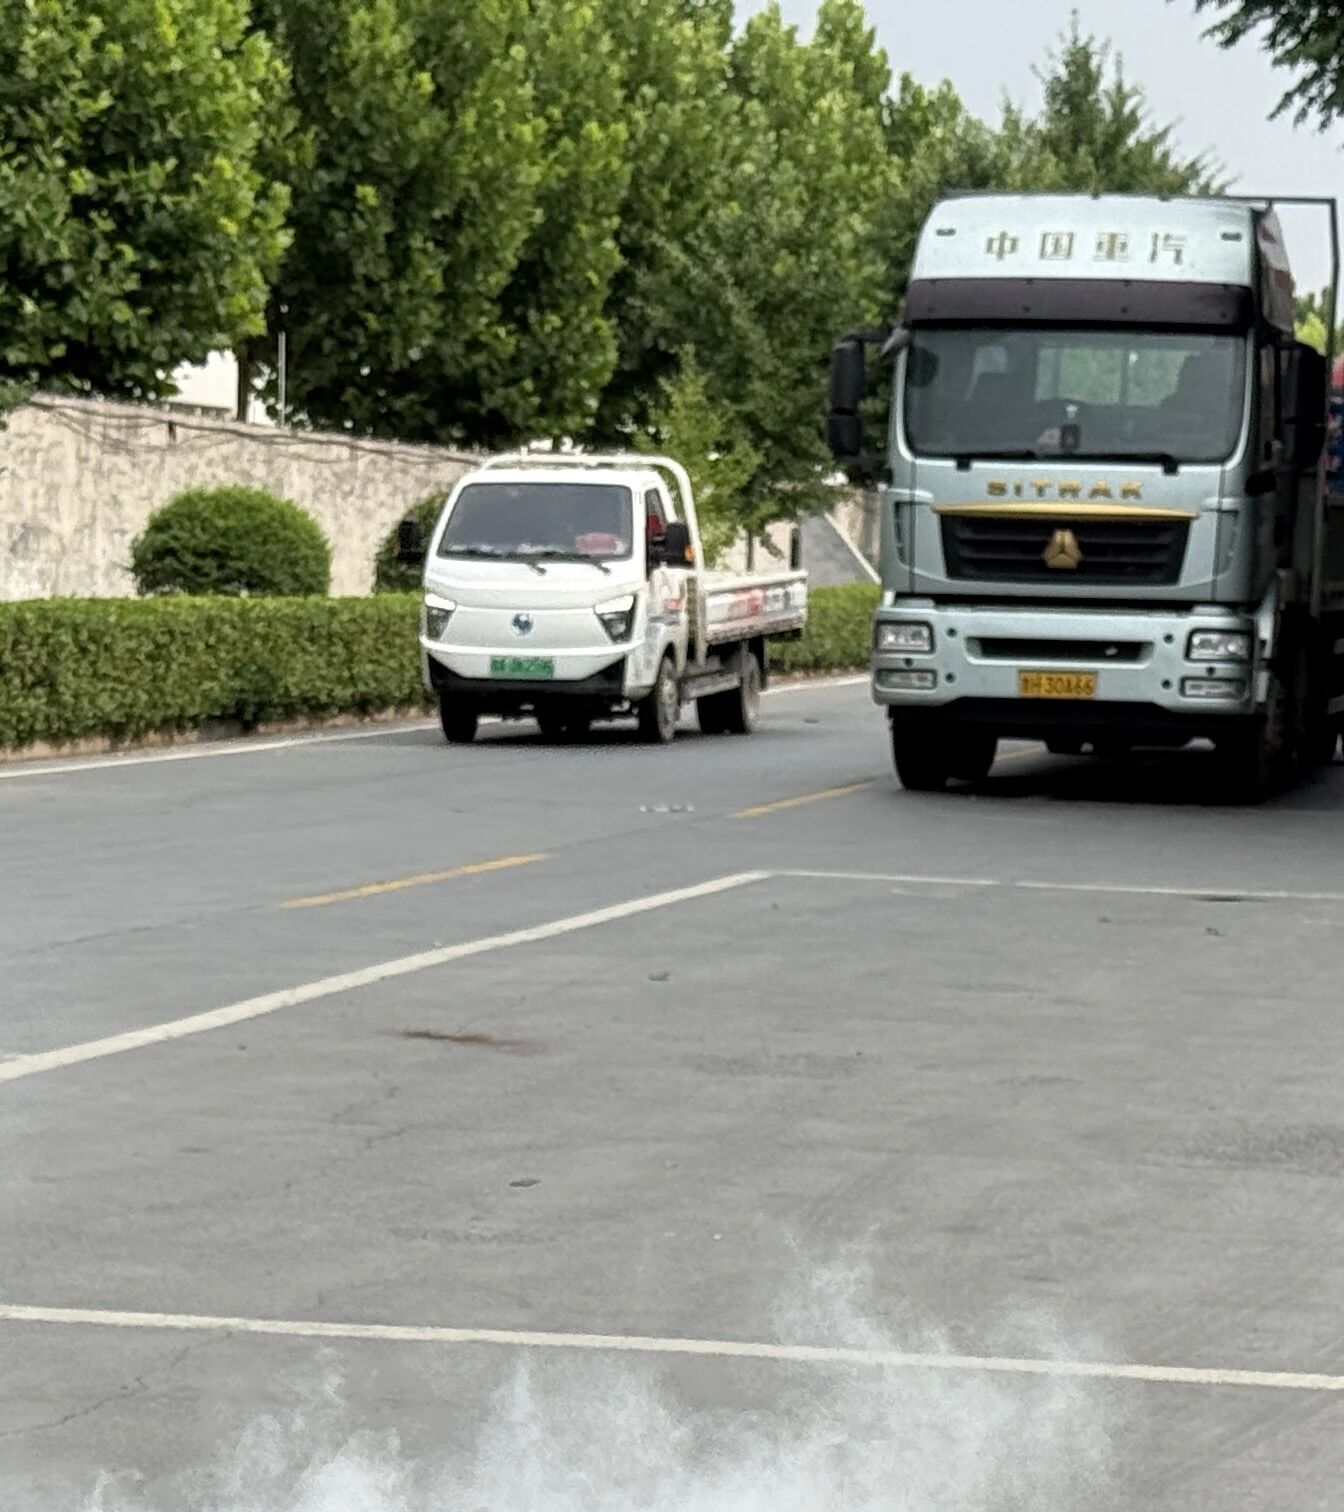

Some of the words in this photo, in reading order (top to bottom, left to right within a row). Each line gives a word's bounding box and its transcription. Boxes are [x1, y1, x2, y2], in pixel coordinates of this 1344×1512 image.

[985, 230, 1188, 265] 中国重汽
[986, 479, 1144, 500] SITRAK
